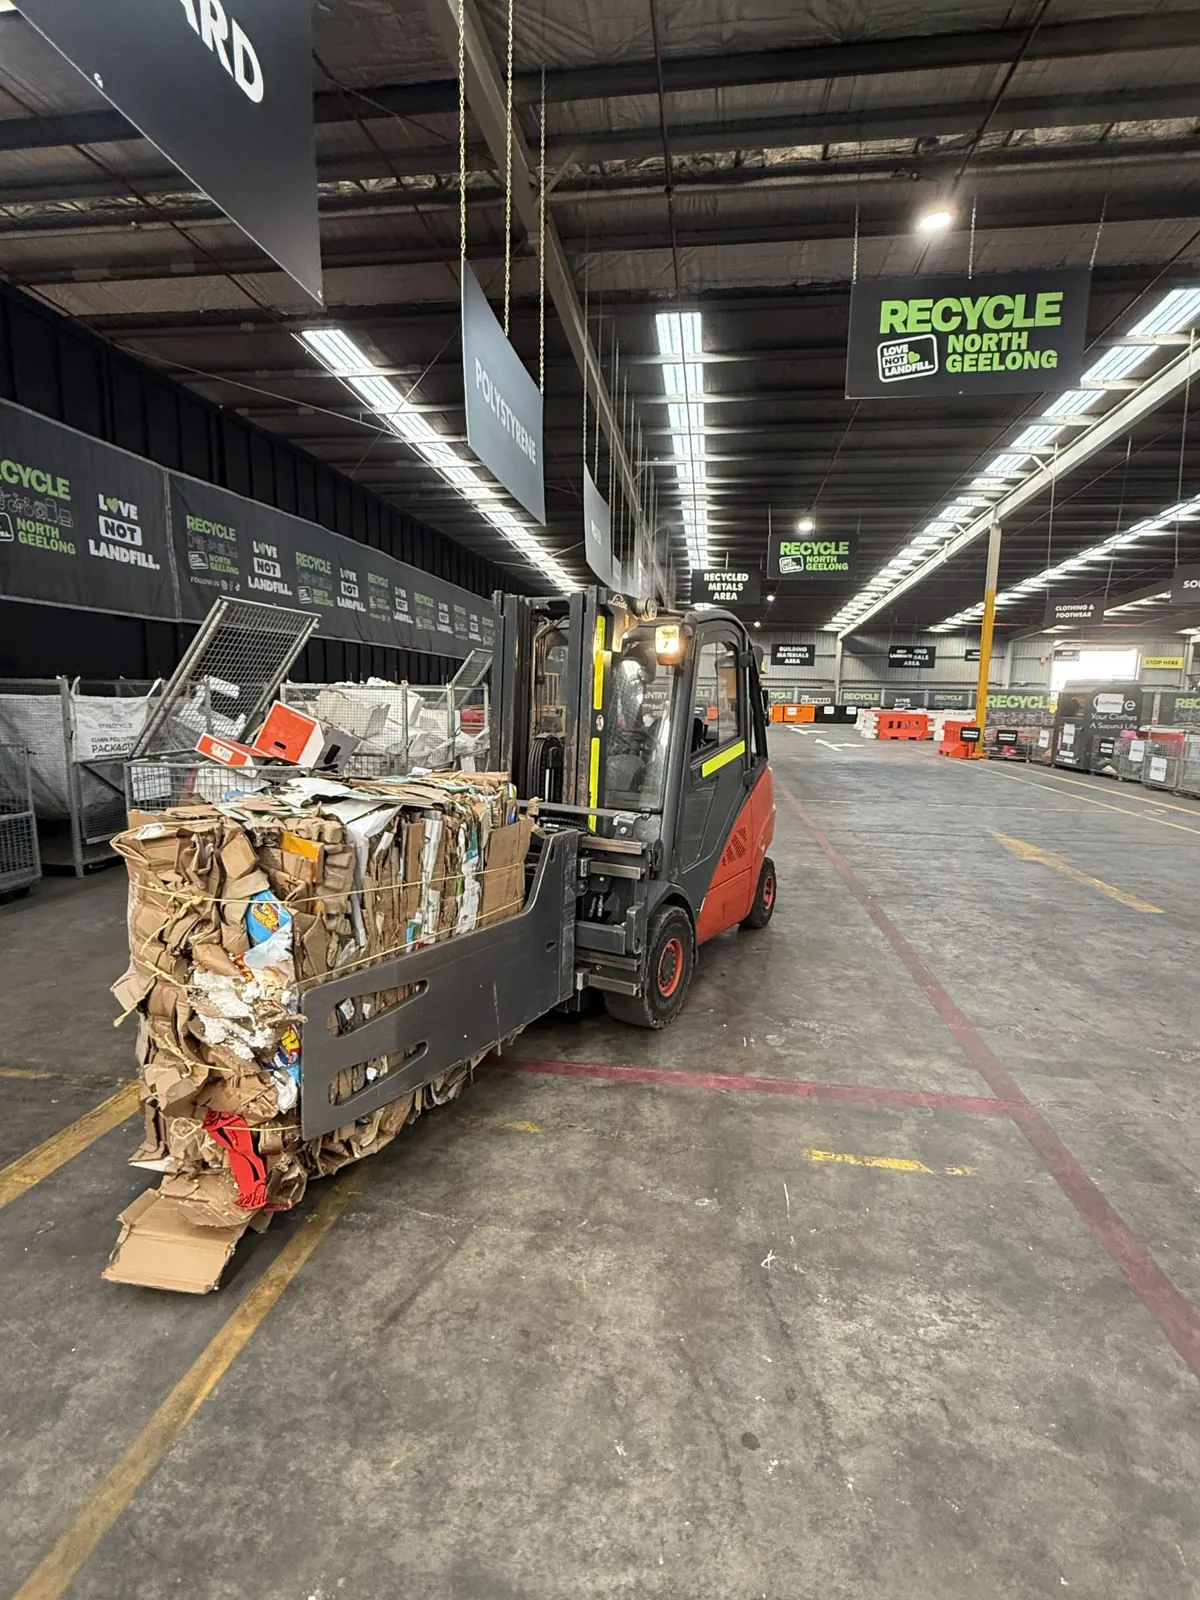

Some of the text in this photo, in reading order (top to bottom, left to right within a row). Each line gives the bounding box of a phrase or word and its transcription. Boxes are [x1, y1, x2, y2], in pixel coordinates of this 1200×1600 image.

[880, 292, 1064, 334] RECYCLE
[947, 332, 1028, 353] NORTH
[883, 344, 909, 357] LOVE
[884, 355, 906, 367] NOT
[945, 350, 1058, 373] GEELONG
[474, 356, 537, 466] POLYSTYRENE
[0, 459, 71, 501] CYCLE
[16, 517, 59, 539] NORTH
[103, 518, 138, 542] NOT
[186, 515, 237, 541] RECYCLE
[18, 530, 77, 555] GEELONG
[779, 541, 849, 555] RECYCLE
[88, 538, 160, 570] LANDFILL.
[806, 555, 837, 563] NORTH
[257, 560, 278, 576] NOT
[295, 551, 332, 575] RECYCLE
[805, 563, 849, 571] GEELONG
[704, 573, 749, 582] RECYCLED
[708, 582, 744, 591] METALS
[607, 594, 628, 610] Linde
[713, 592, 738, 600] AREA
[1055, 604, 1087, 612] CLOTHING
[1056, 611, 1092, 619] FOOTWEAR
[843, 693, 880, 701] RECYCLE
[1175, 697, 1200, 708] REC
[1091, 712, 1138, 721] Your Clothes
